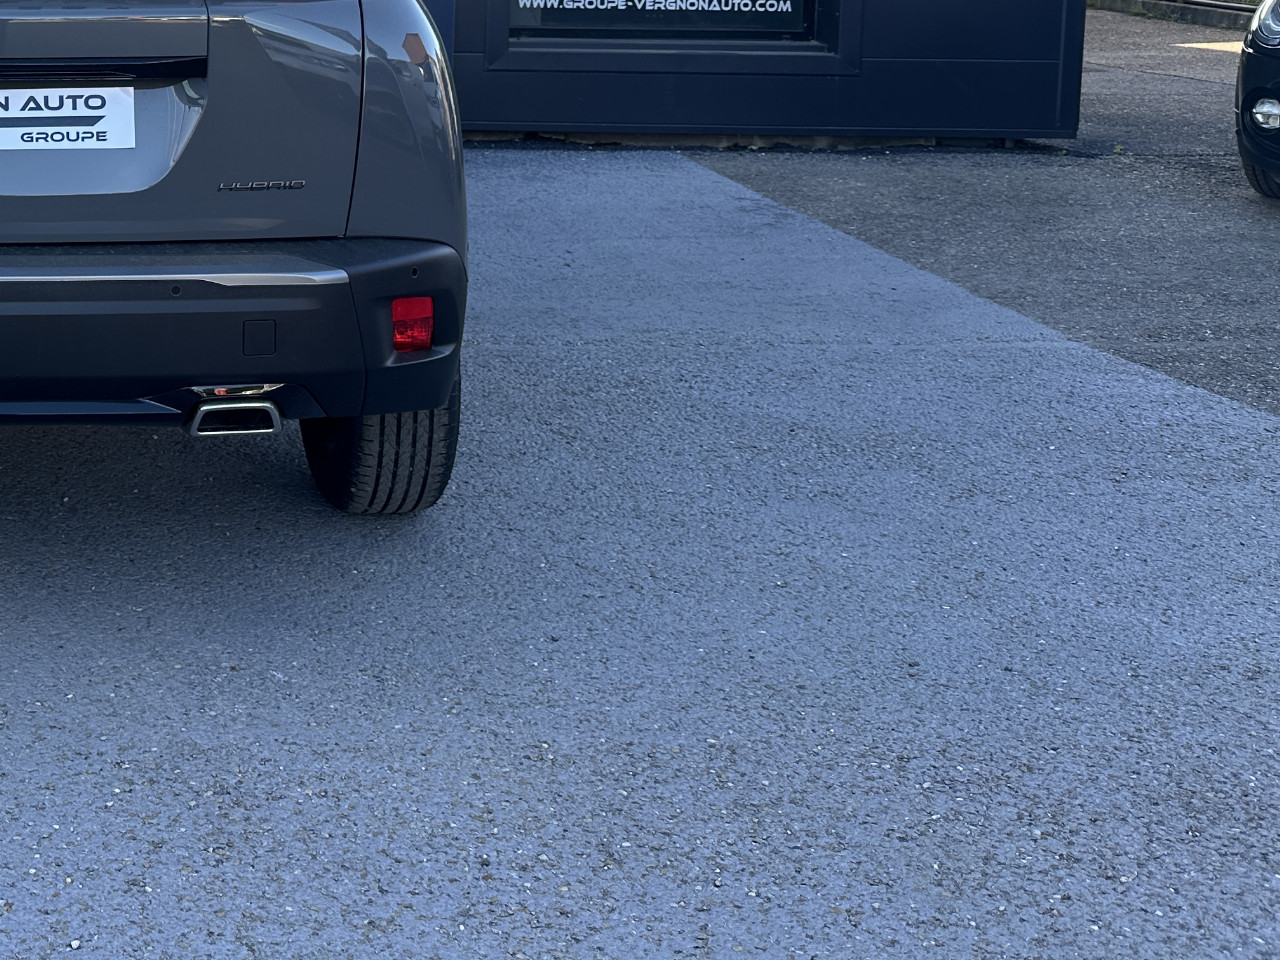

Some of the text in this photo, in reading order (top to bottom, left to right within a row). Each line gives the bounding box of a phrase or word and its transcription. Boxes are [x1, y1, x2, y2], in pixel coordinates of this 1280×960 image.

[19, 94, 107, 112] AUTO
[20, 131, 108, 143] GROUPE
[217, 179, 306, 192] HYBRID
